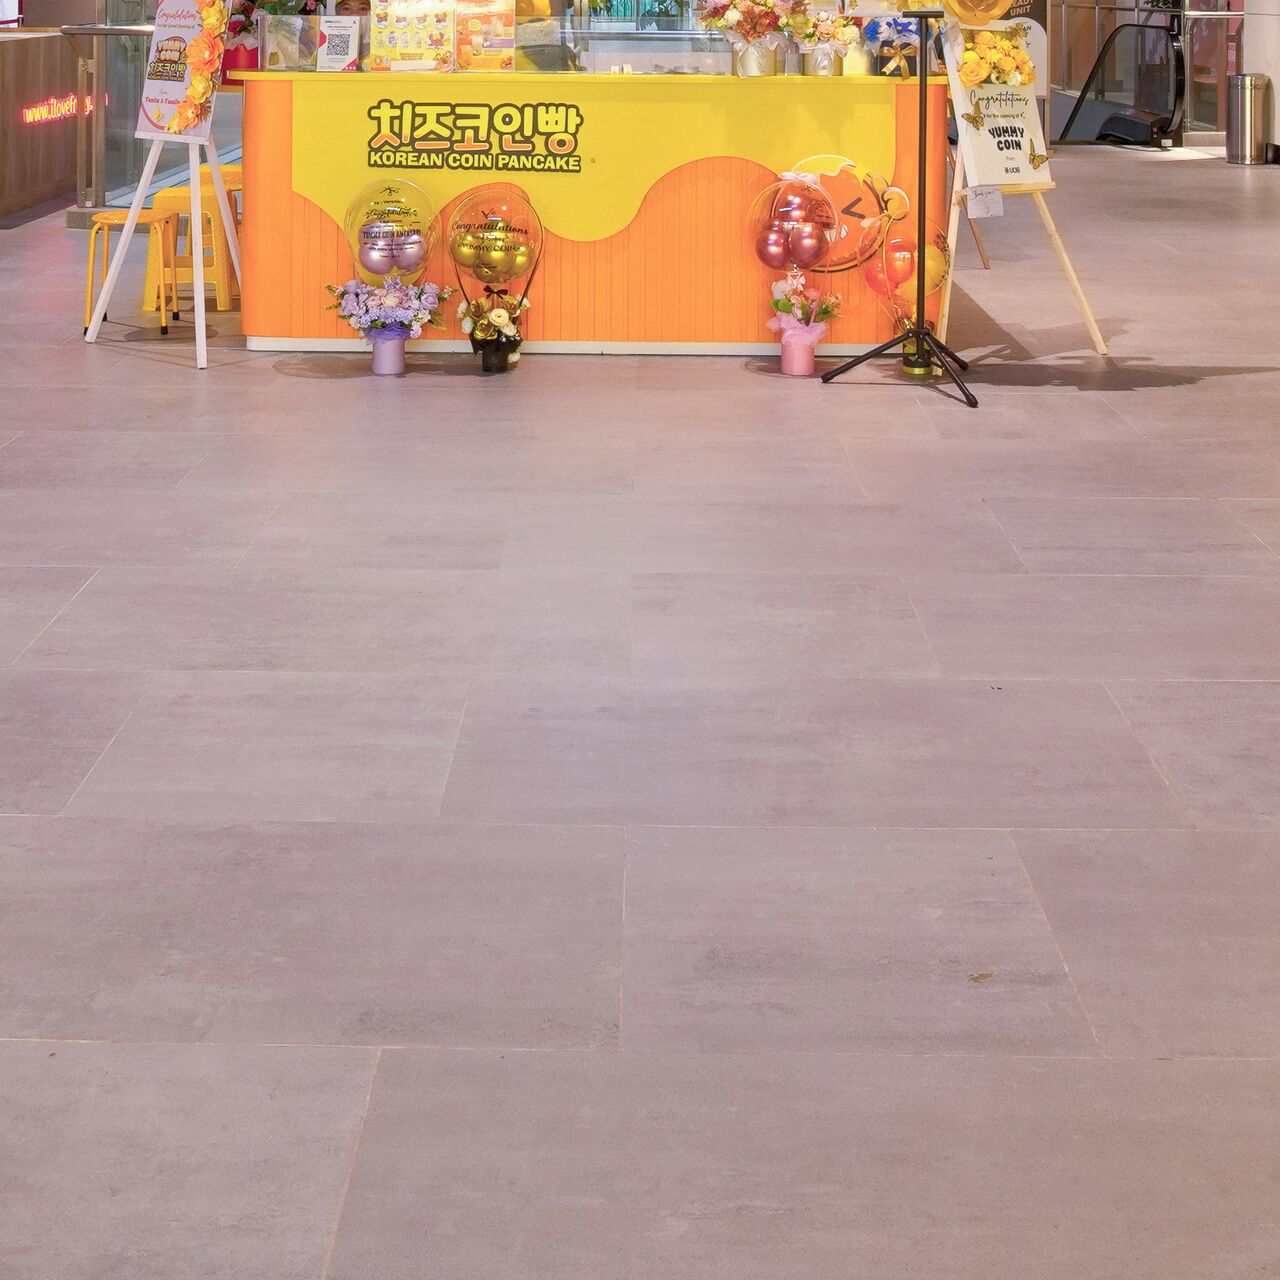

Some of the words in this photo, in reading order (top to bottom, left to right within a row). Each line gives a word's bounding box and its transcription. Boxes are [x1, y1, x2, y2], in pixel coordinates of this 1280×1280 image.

[1010, 5, 1031, 16] UNIT
[369, 100, 583, 154] 치즈코인빵
[988, 125, 1024, 139] YUMMY
[997, 139, 1022, 151] COIN
[370, 151, 442, 167] KOREAN
[448, 153, 492, 168] COIN
[498, 155, 581, 171] PANCAKE
[452, 221, 528, 235] Congratulations
